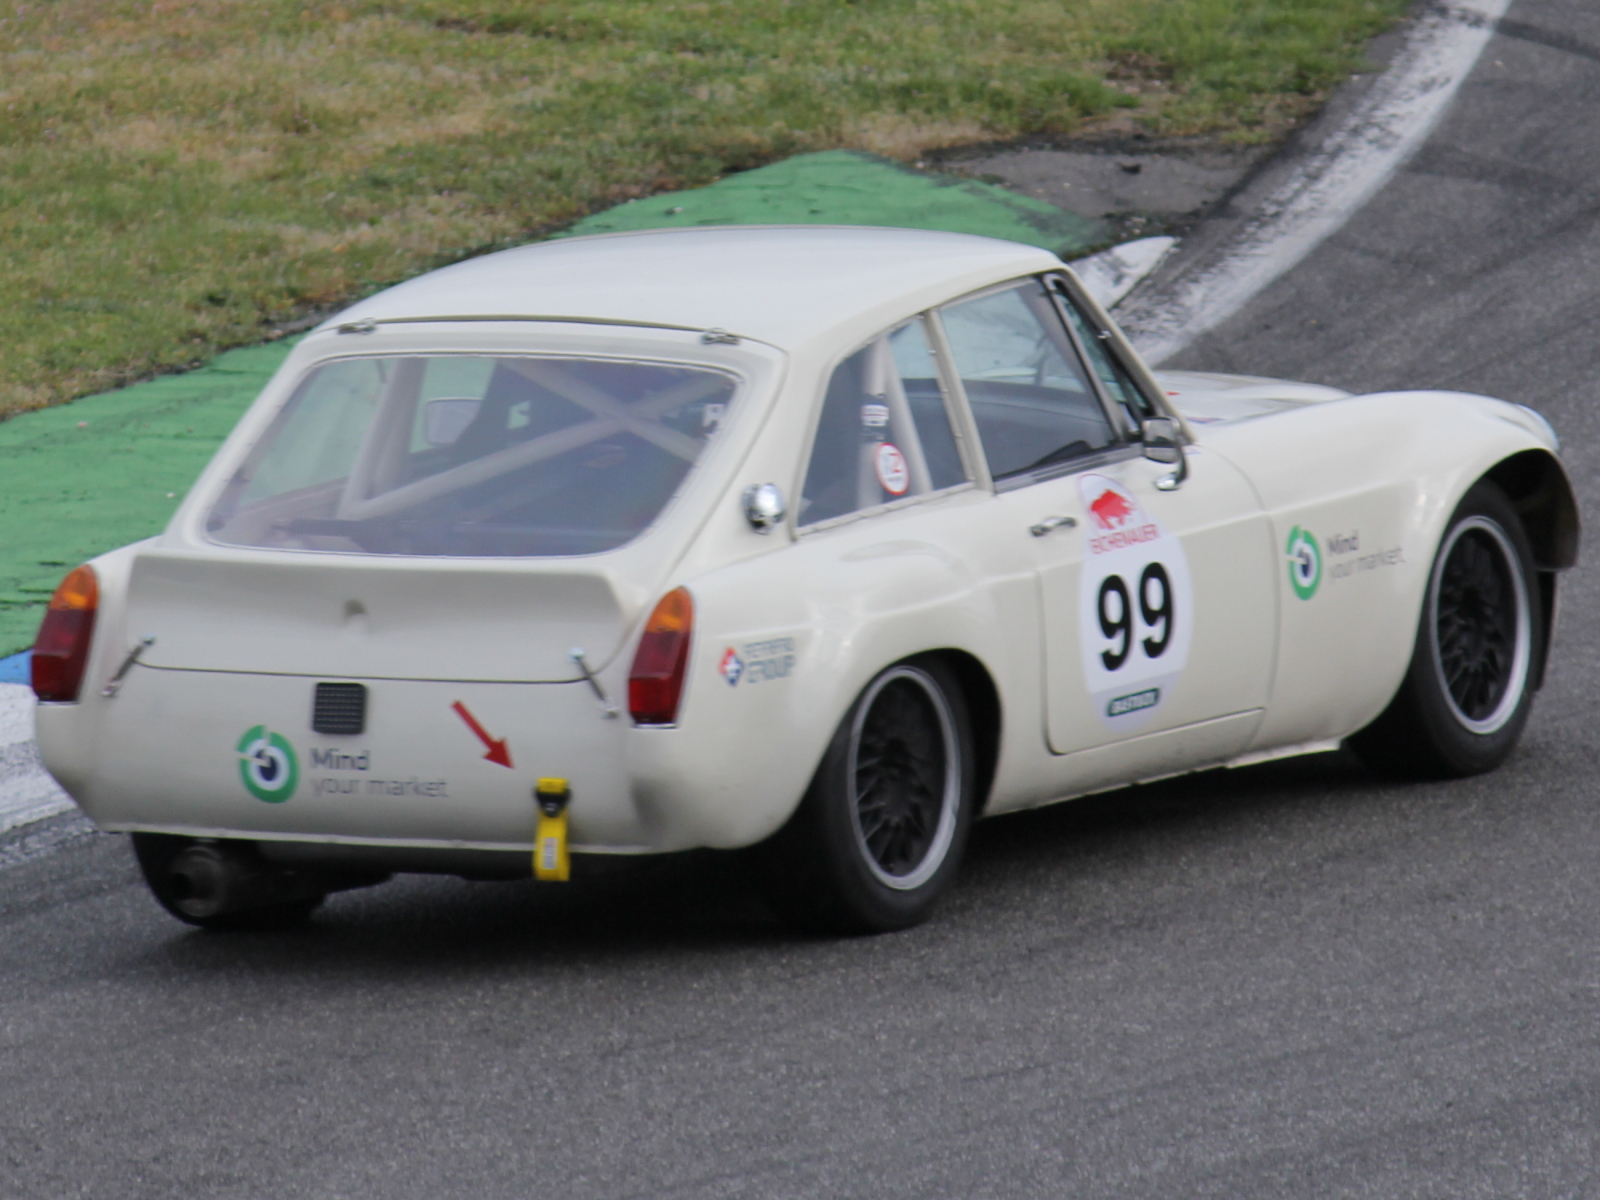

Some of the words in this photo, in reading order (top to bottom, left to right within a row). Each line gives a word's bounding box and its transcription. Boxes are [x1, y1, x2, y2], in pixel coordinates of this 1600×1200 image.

[1089, 523, 1161, 555] EICHENAUER
[1327, 530, 1359, 556] Mind
[1328, 559, 1355, 584] your
[1098, 562, 1173, 671] 99
[309, 748, 369, 770] Mind
[309, 777, 358, 797] your
[366, 775, 448, 798] market
